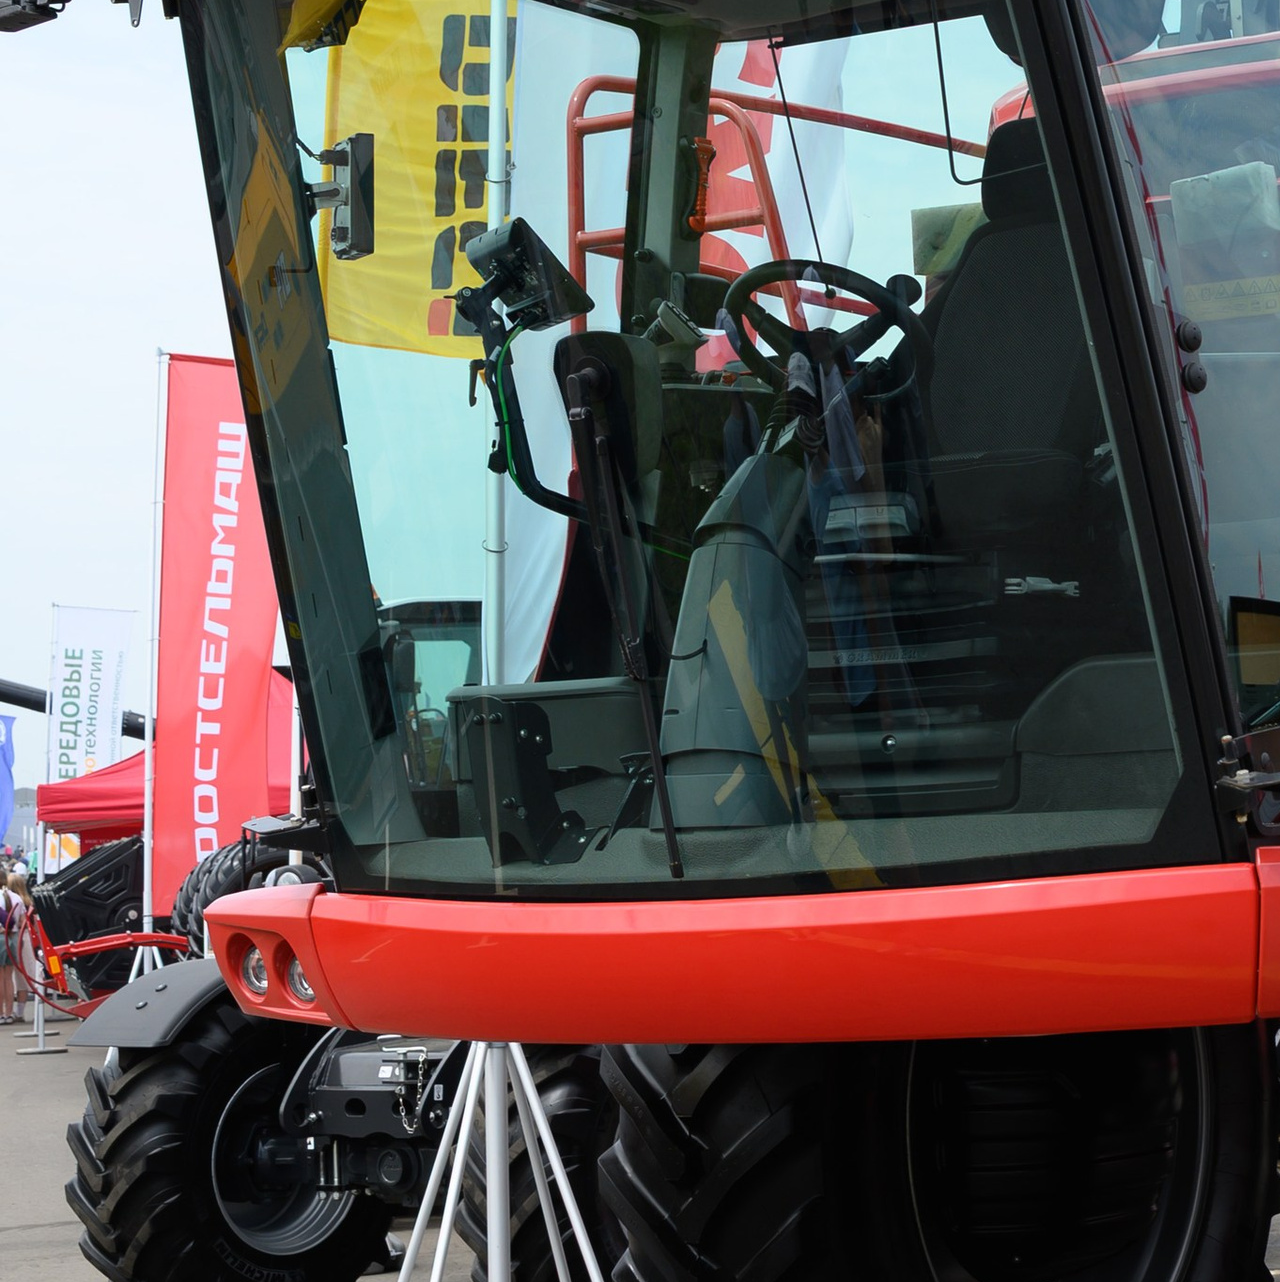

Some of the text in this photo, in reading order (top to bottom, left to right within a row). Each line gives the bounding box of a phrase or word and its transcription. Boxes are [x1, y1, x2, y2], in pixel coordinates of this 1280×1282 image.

[193, 420, 248, 863] РОСТСЕЛЬМАШ
[58, 648, 84, 780] ЕРЕДОВЫЕ
[84, 649, 104, 775] отехнологии
